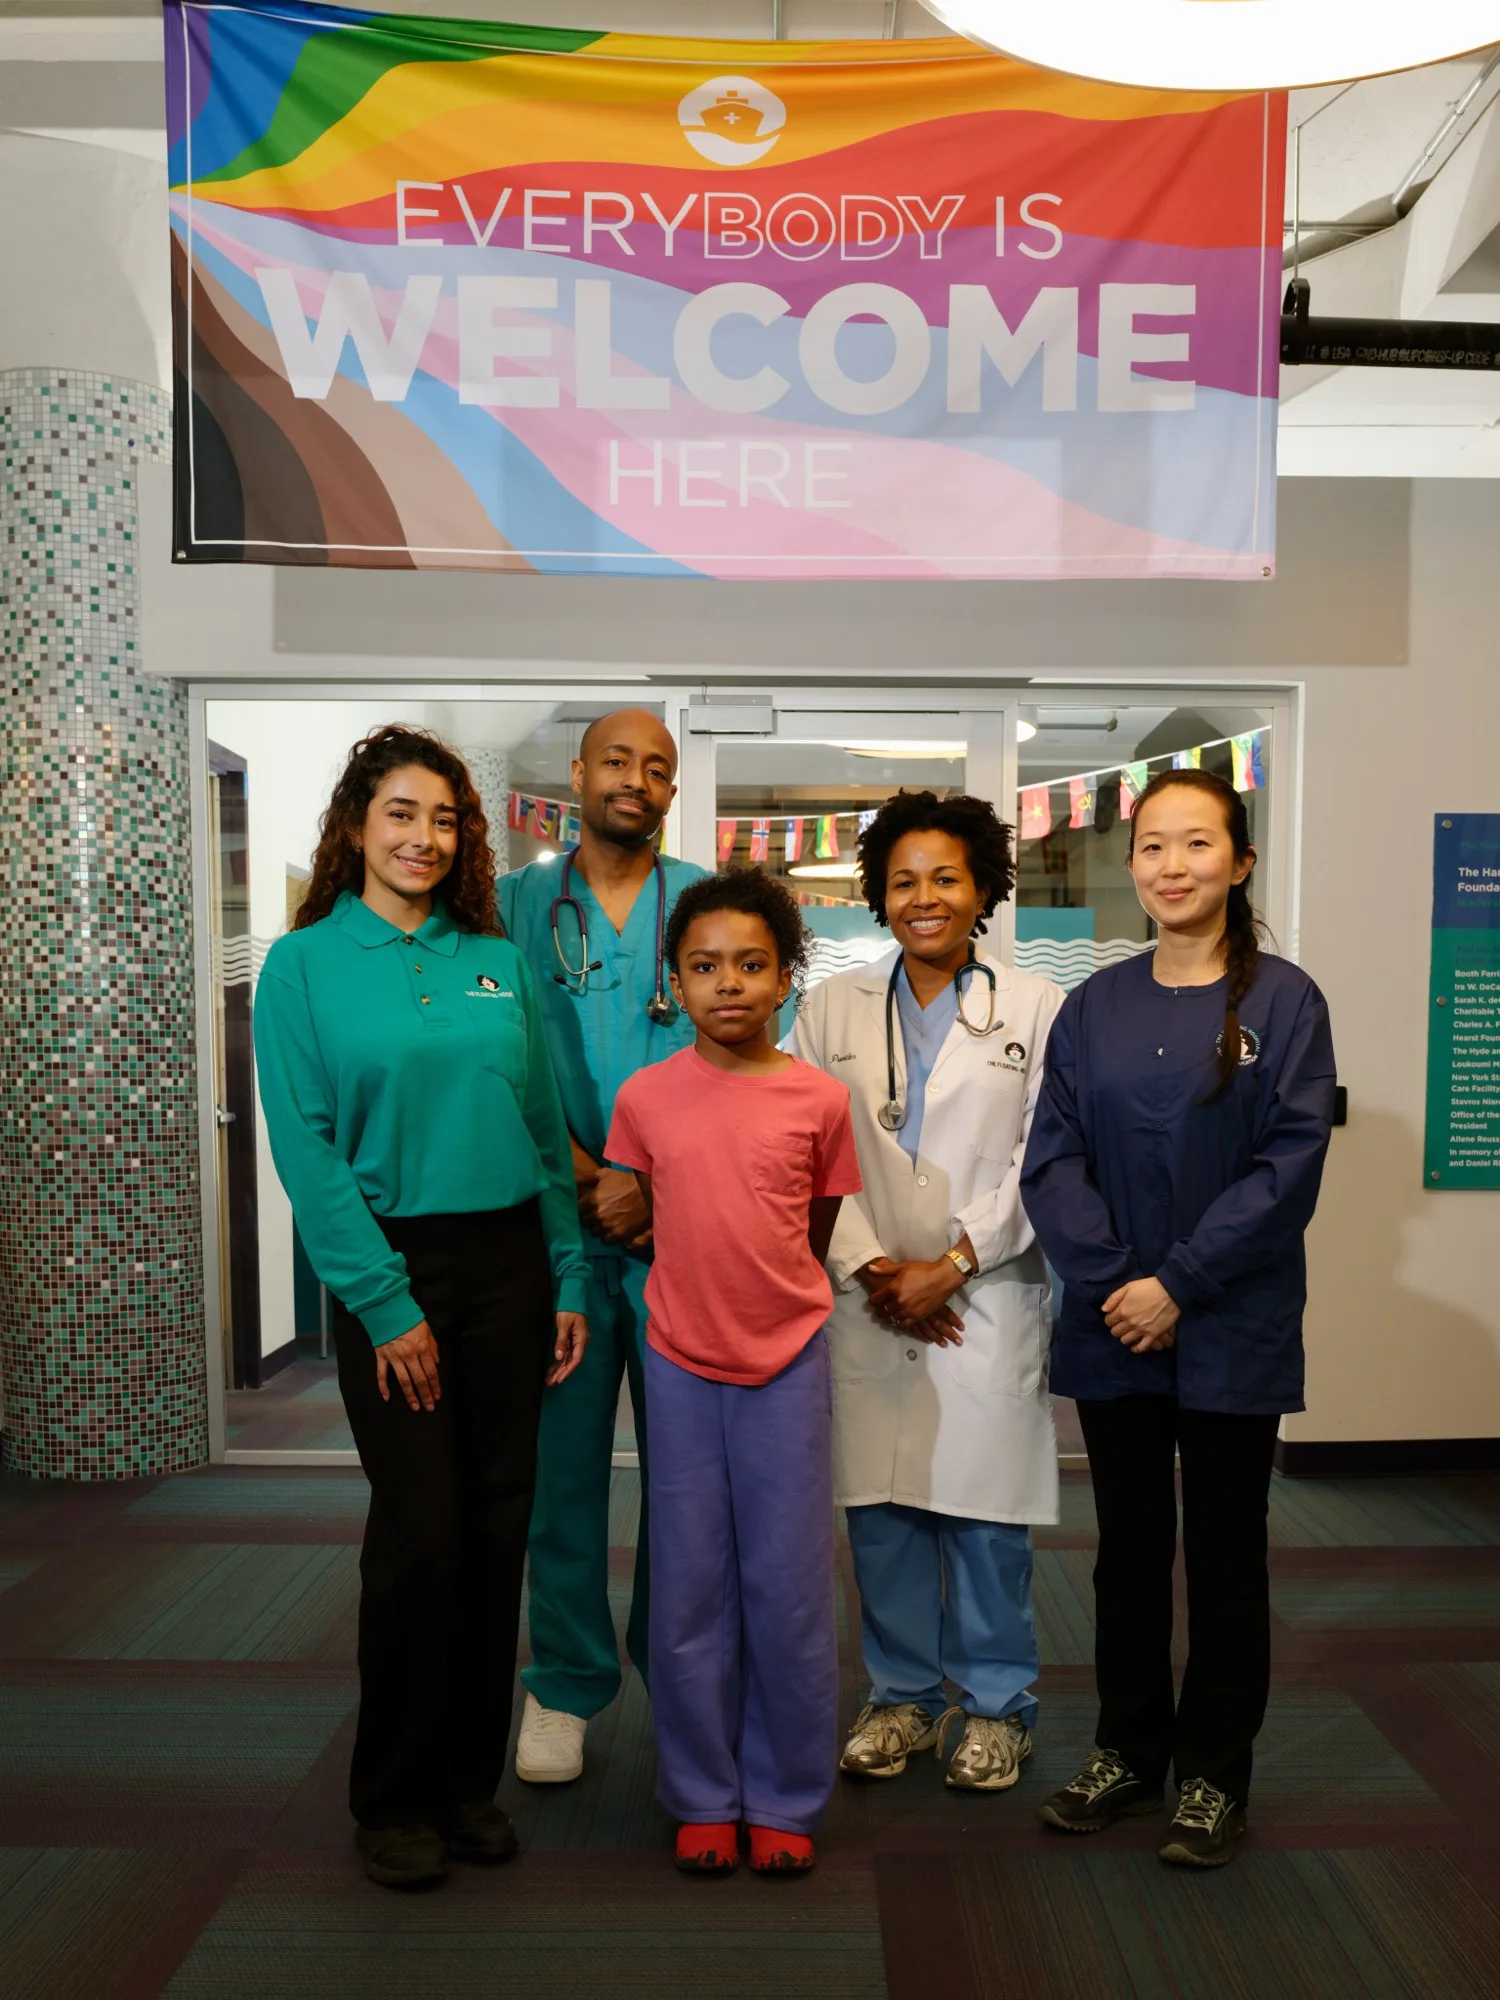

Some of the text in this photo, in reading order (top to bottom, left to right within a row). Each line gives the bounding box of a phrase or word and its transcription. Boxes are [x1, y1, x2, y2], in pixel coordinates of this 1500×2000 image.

[396, 180, 1063, 261] EVERYBODY IS
[254, 267, 1197, 415] WELCOME
[609, 440, 853, 509] HERE
[1458, 867, 1479, 877] The
[1455, 969, 1479, 978] Booth
[1454, 983, 1465, 991] Ira
[1467, 983, 1477, 991] W.
[1453, 1008, 1495, 1016] Charitable
[1453, 1020, 1483, 1029] Charles
[1453, 1034, 1479, 1042] Hearst
[1452, 1047, 1468, 1055] The
[1469, 1047, 1490, 1056] Hyde
[1452, 1060, 1491, 1068] Loukoumi
[1451, 1085, 1500, 1094] Care Facility
[1450, 1098, 1480, 1106] Stavros
[1450, 1111, 1500, 1119] Office of the
[1450, 1122, 1488, 1130] President
[1477, 1135, 1500, 1143] Reuss
[1459, 1149, 1492, 1157] memory
[1465, 1159, 1491, 1167] Daniel
